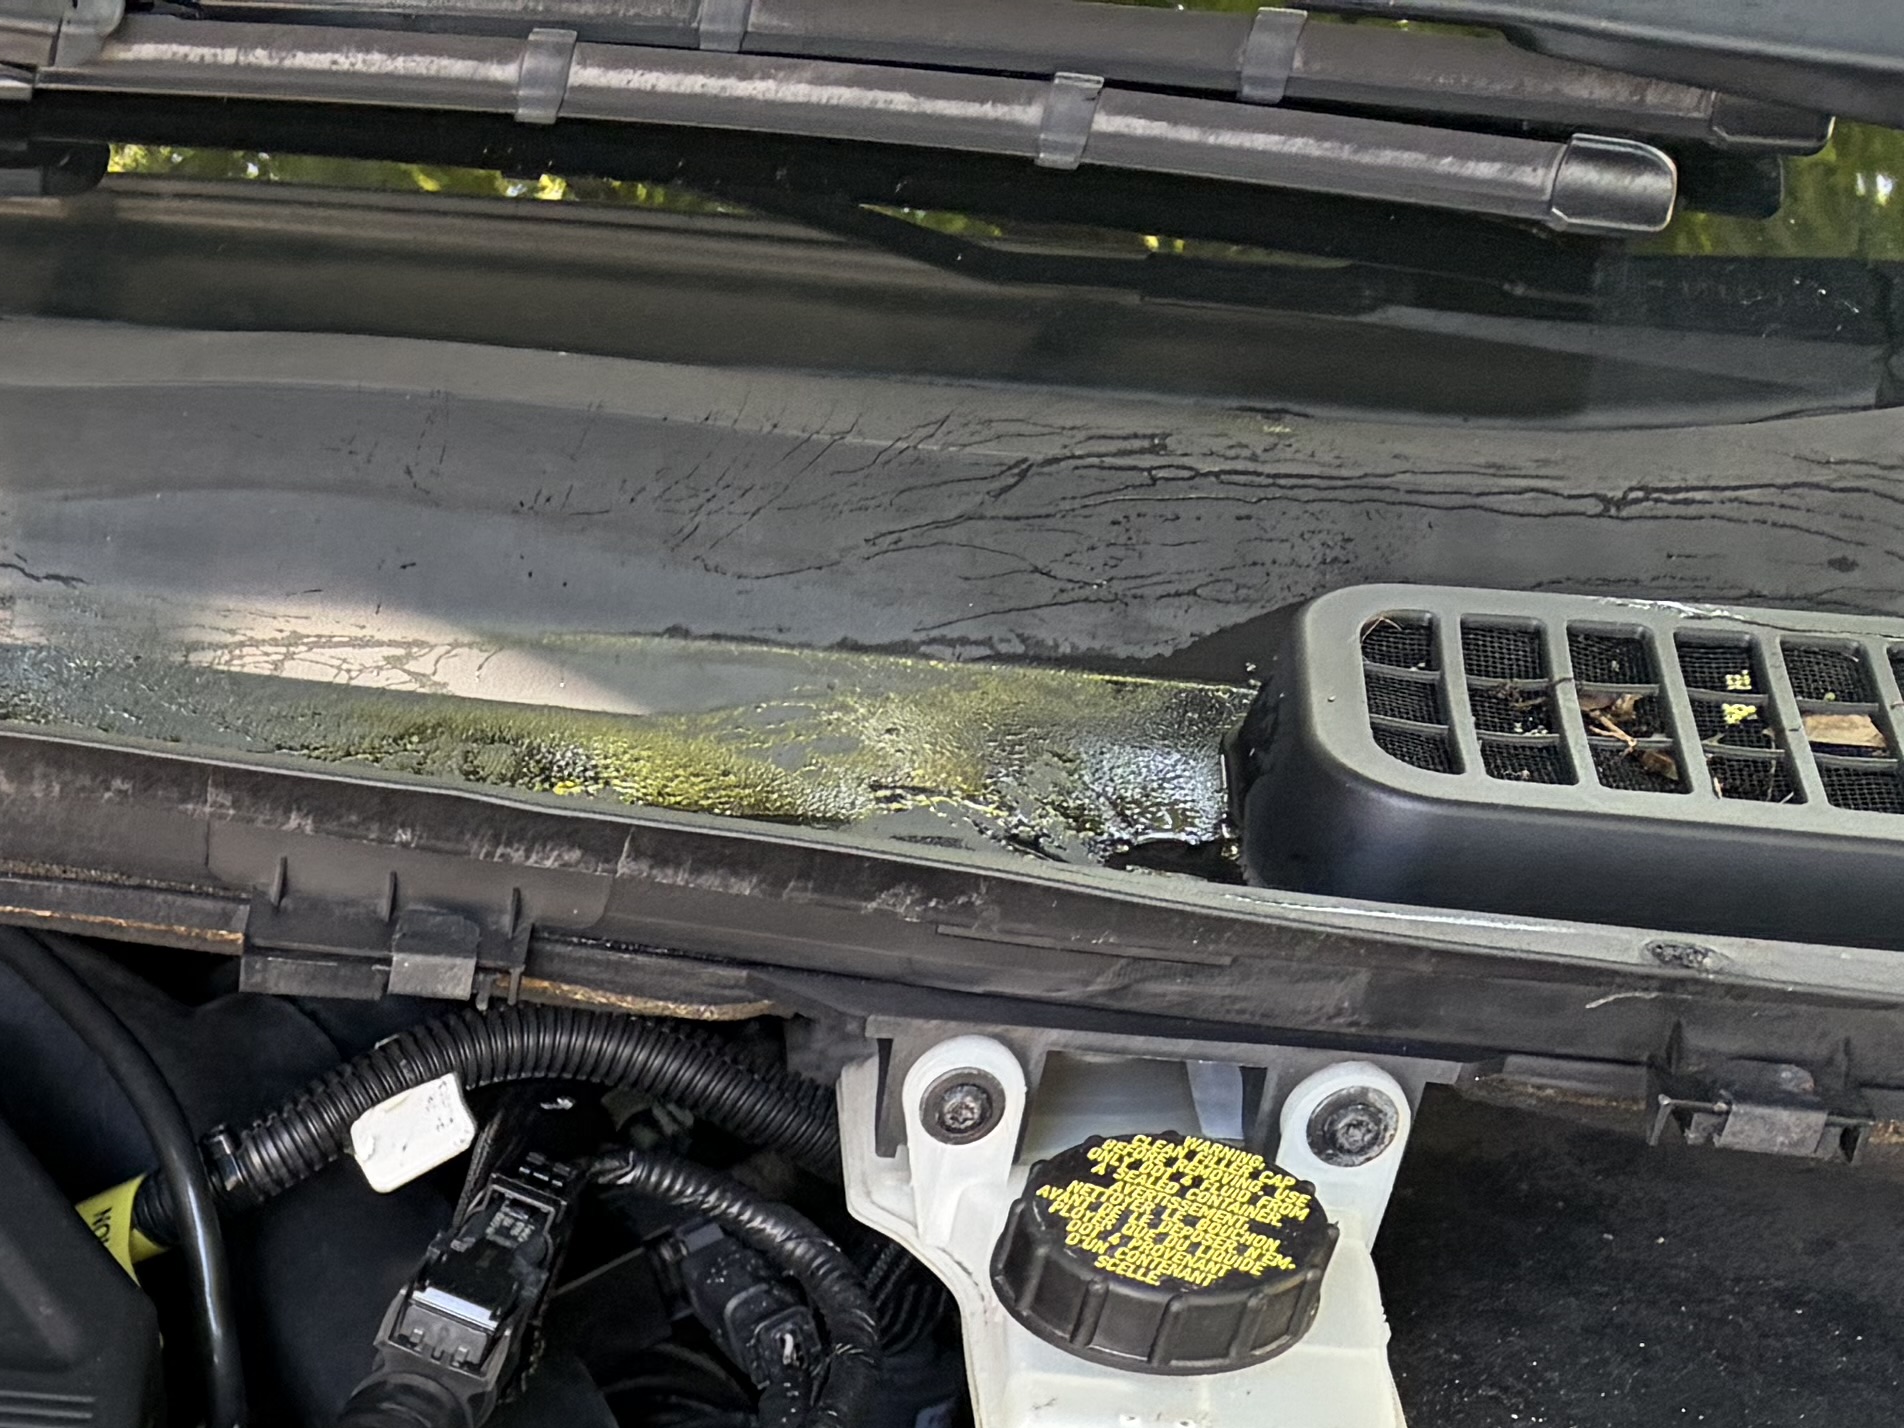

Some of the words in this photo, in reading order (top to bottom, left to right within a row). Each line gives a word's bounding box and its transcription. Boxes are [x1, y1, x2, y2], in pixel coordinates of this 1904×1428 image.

[1087, 1147, 1134, 1168] ONLY
[1139, 1161, 1173, 1180] DOT
[1200, 1180, 1252, 1202] FLUID
[1256, 1196, 1310, 1221] FROM
[1102, 1139, 1167, 1164] BEFORE
[1274, 1187, 1311, 1208] USE
[1132, 1135, 1189, 1159] CLEAN
[1193, 1152, 1253, 1178] FILLER
[1259, 1171, 1296, 1188] CAP
[1036, 1185, 1095, 1208] AVANT
[1098, 1202, 1125, 1220] DE
[1128, 1211, 1154, 1228] LE
[1067, 1180, 1156, 1214] NETTOYER
[1161, 1208, 1186, 1223] LE
[1196, 1218, 1280, 1254] BOUCHON
[1091, 1162, 1107, 1175] A
[1113, 1168, 1180, 1194] SEALED
[1186, 1188, 1282, 1227] CONTAINER.
[1048, 1200, 1116, 1230] PLOYER
[1121, 1223, 1159, 1242] QUE
[1163, 1235, 1190, 1251] DU
[1195, 1245, 1266, 1276] LIQUIDE
[1066, 1220, 1102, 1239] DOT
[1127, 1238, 1231, 1277] PROVENANT
[1114, 1247, 1217, 1286] CONTENANT
